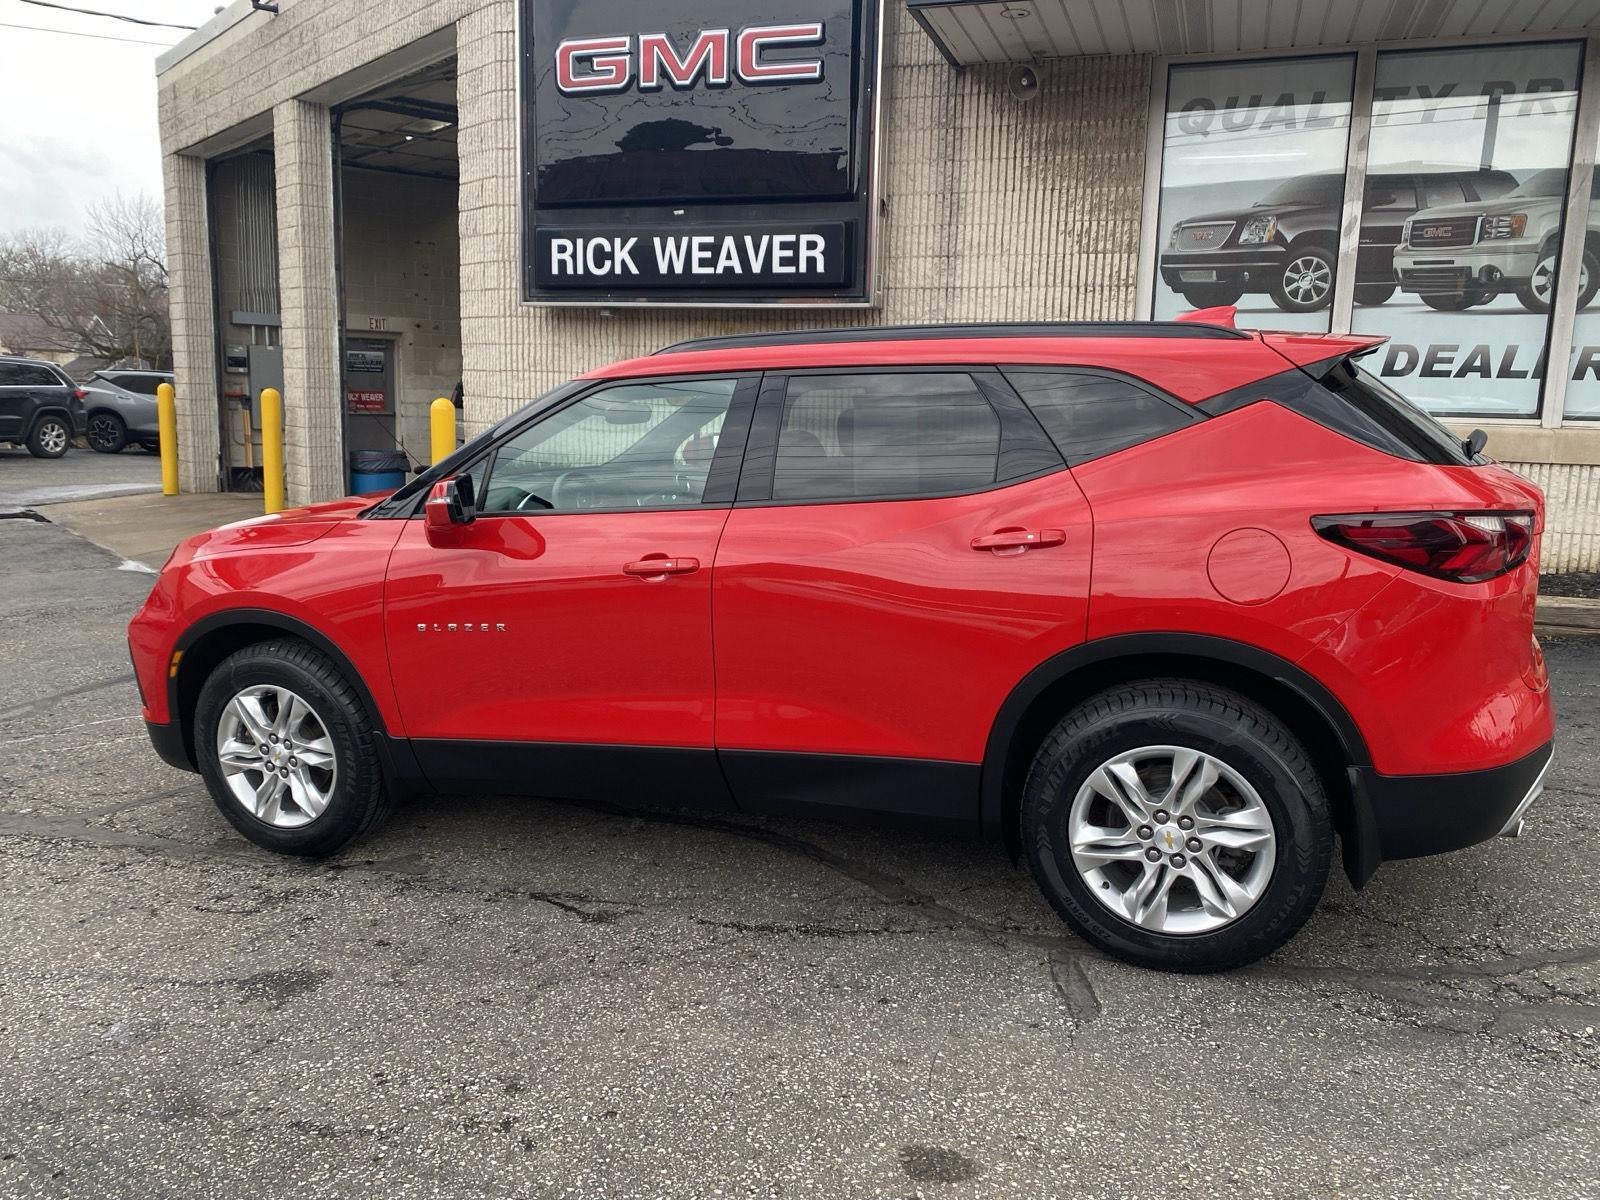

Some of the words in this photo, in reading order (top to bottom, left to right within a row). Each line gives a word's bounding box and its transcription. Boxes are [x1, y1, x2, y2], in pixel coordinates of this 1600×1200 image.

[555, 22, 824, 94] GMC
[551, 237, 640, 275] RICK
[653, 234, 826, 275] WEAVER
[369, 317, 386, 330] EXIT
[361, 392, 384, 401] WEAVER
[416, 623, 507, 632] BLAZER
